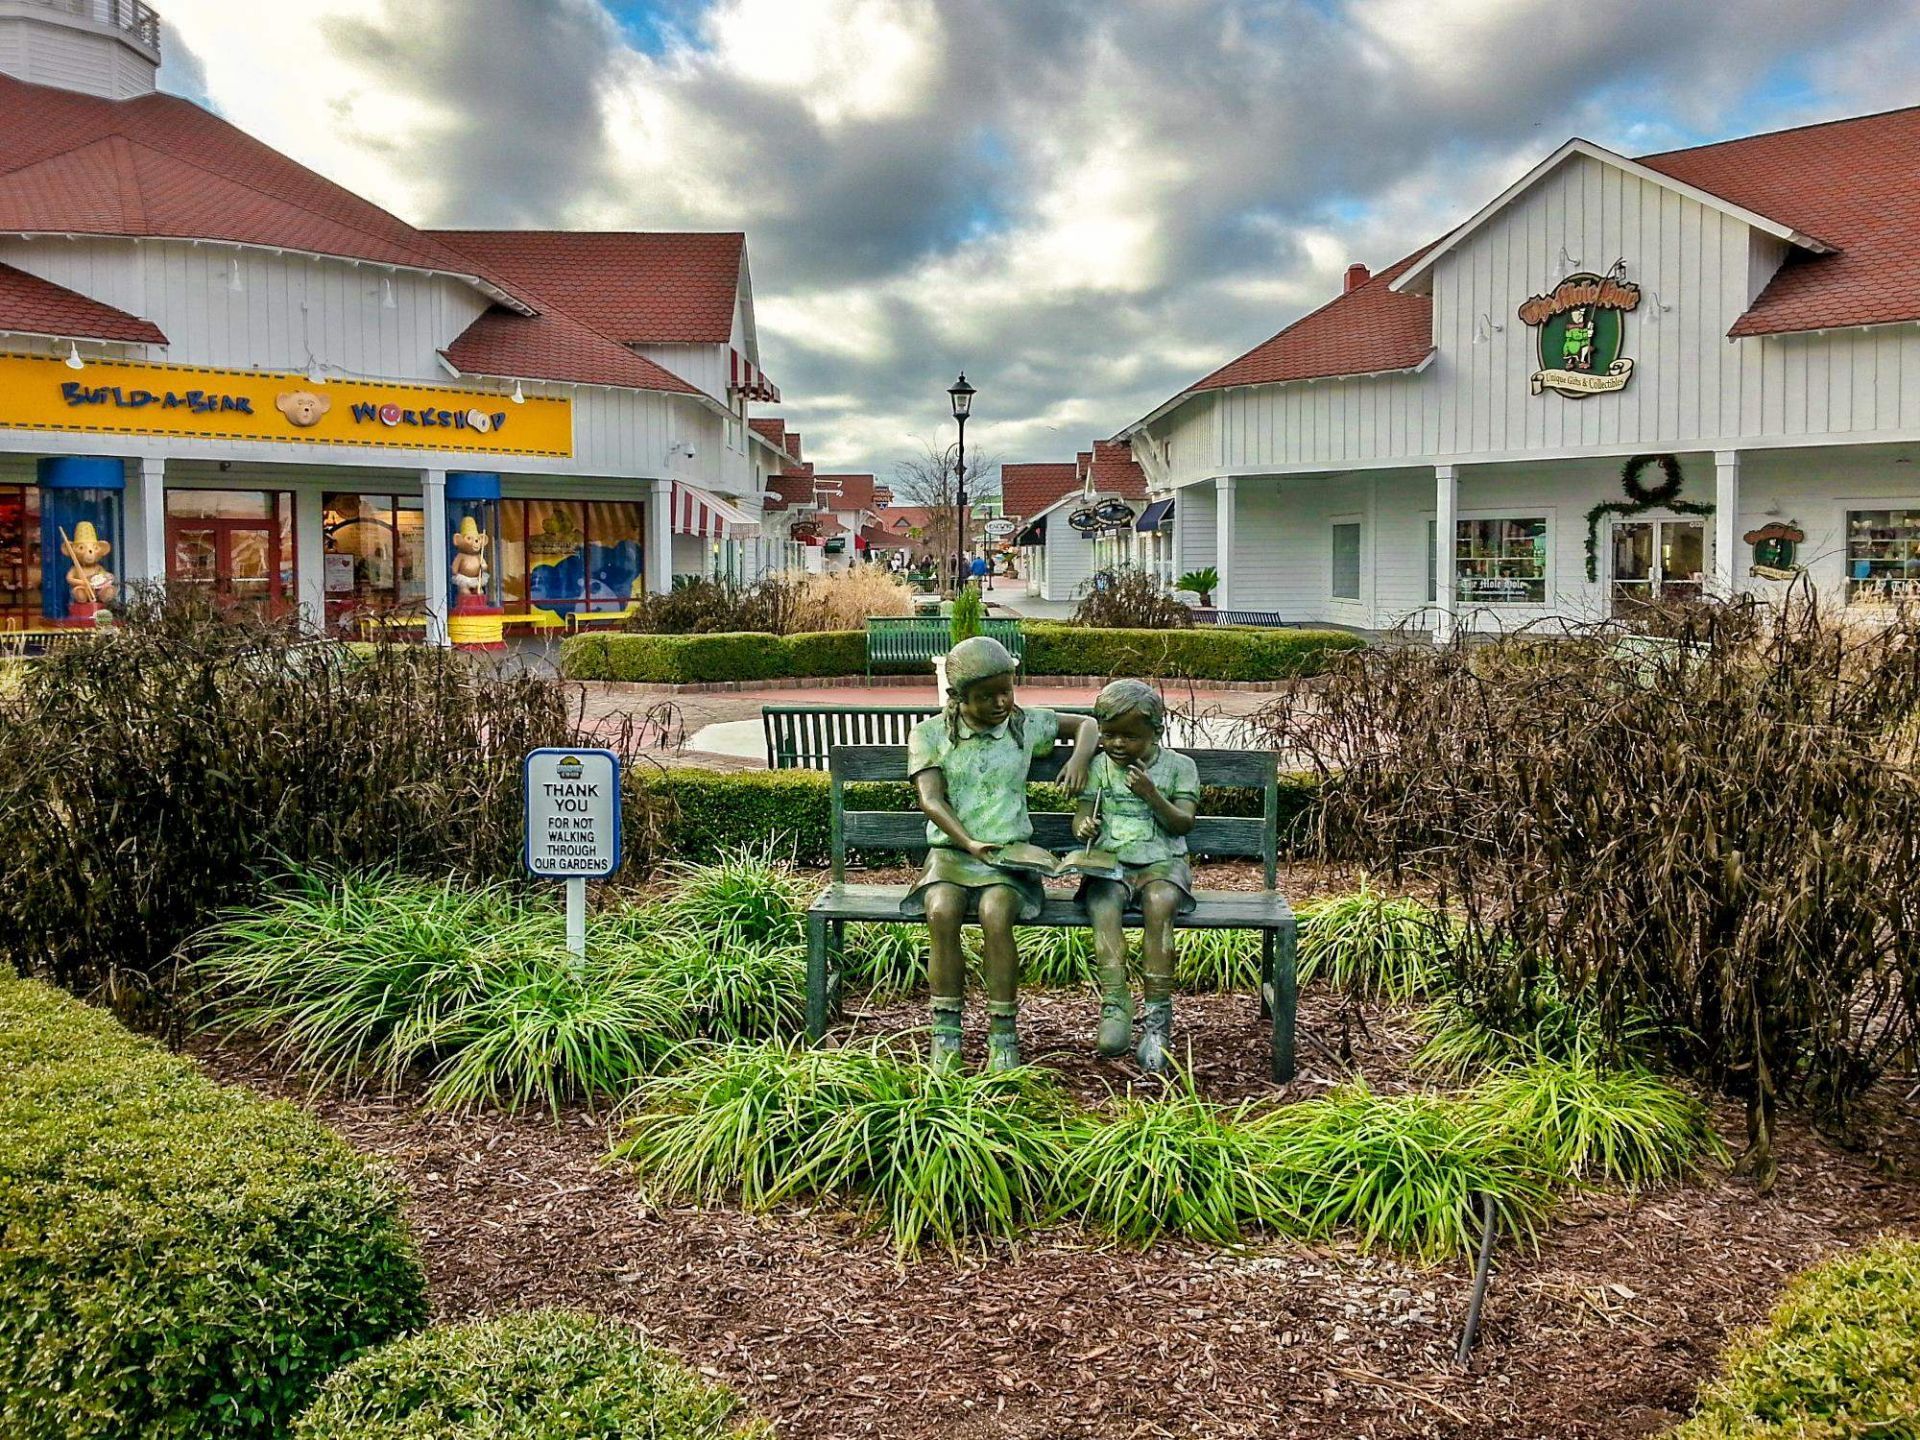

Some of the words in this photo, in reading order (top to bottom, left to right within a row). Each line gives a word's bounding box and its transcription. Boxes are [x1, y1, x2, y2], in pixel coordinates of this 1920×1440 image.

[1546, 372, 1566, 385] Unique
[1582, 378, 1588, 387] &
[1588, 377, 1624, 390] Collectibles
[351, 402, 506, 433] WORKSHOP
[543, 784, 599, 797] THANK
[555, 799, 588, 812] YOU
[548, 817, 569, 829] FOR
[573, 817, 594, 829] NOT
[548, 831, 594, 842] WALKING
[547, 845, 596, 856] THROUGH
[535, 858, 556, 869] OUR
[559, 859, 608, 869] GARDENS
